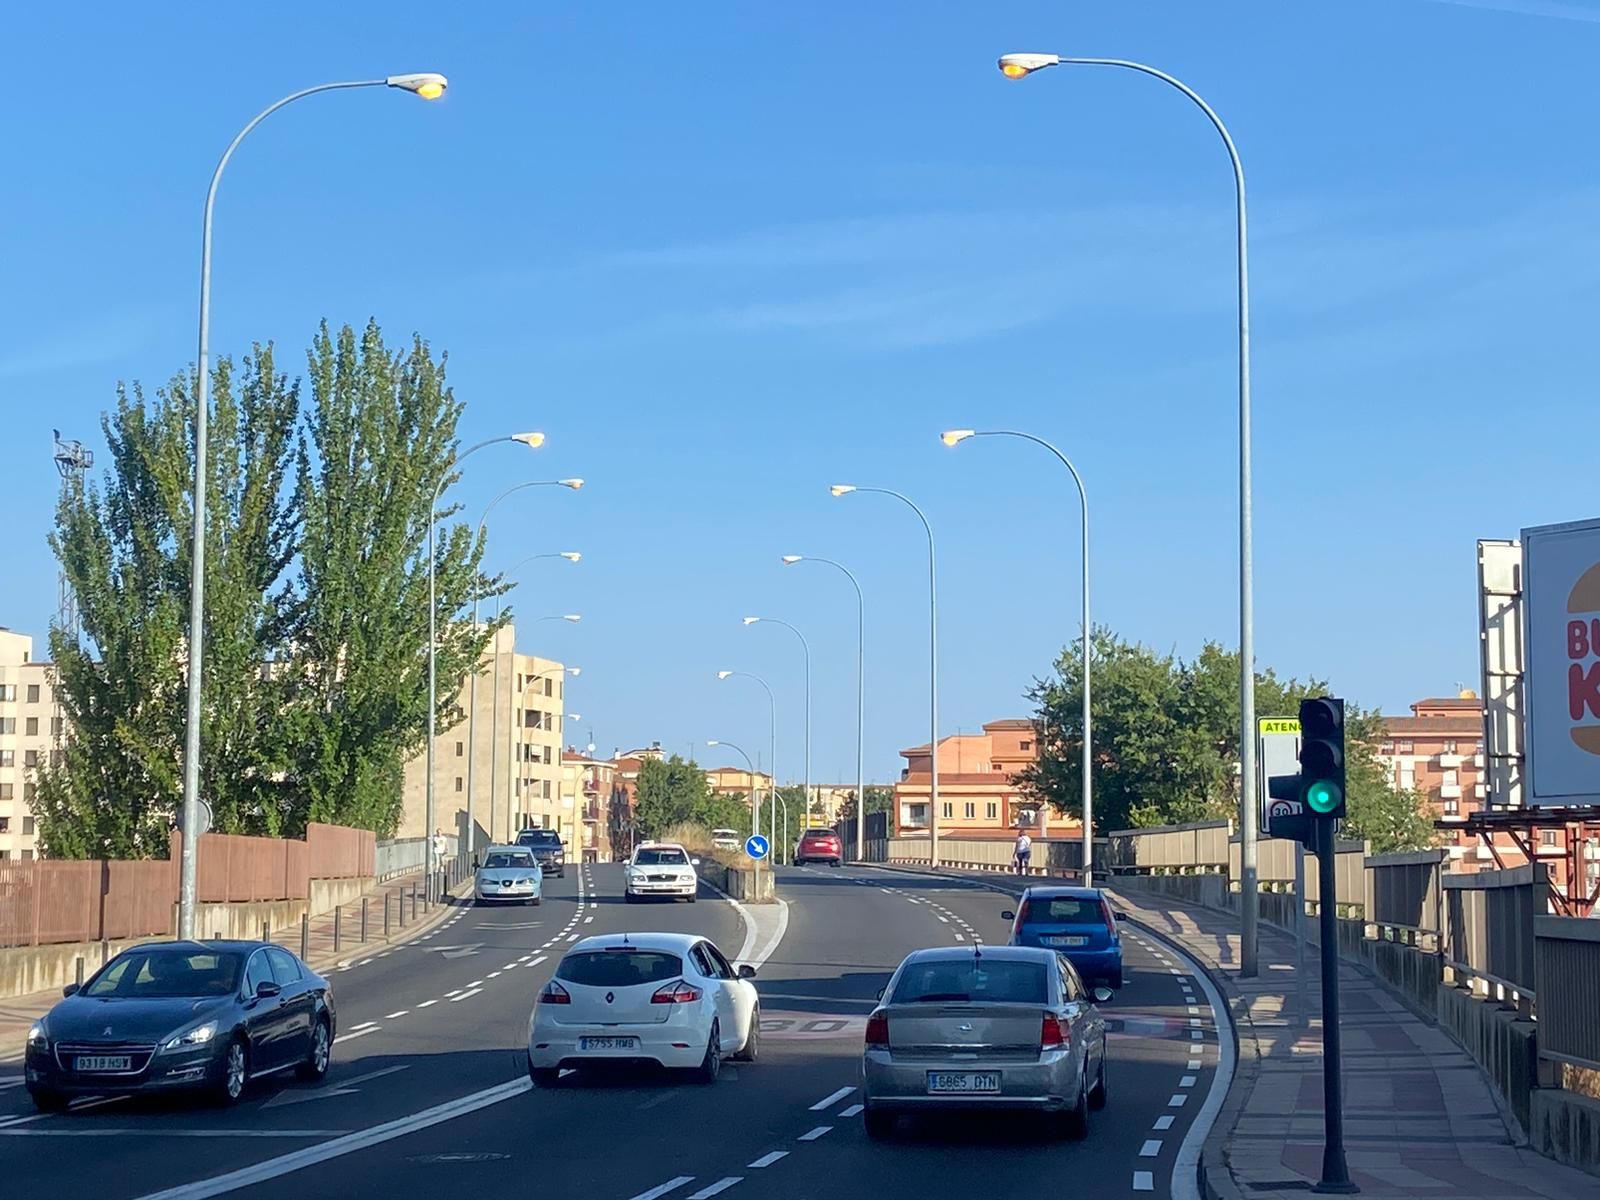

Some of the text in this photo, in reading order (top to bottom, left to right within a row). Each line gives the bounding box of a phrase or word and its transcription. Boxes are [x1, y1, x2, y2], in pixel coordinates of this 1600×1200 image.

[1274, 807, 1288, 816] 30
[588, 1038, 613, 1049] 5755
[79, 1058, 105, 1068] 9318
[939, 1075, 967, 1088] 6865
